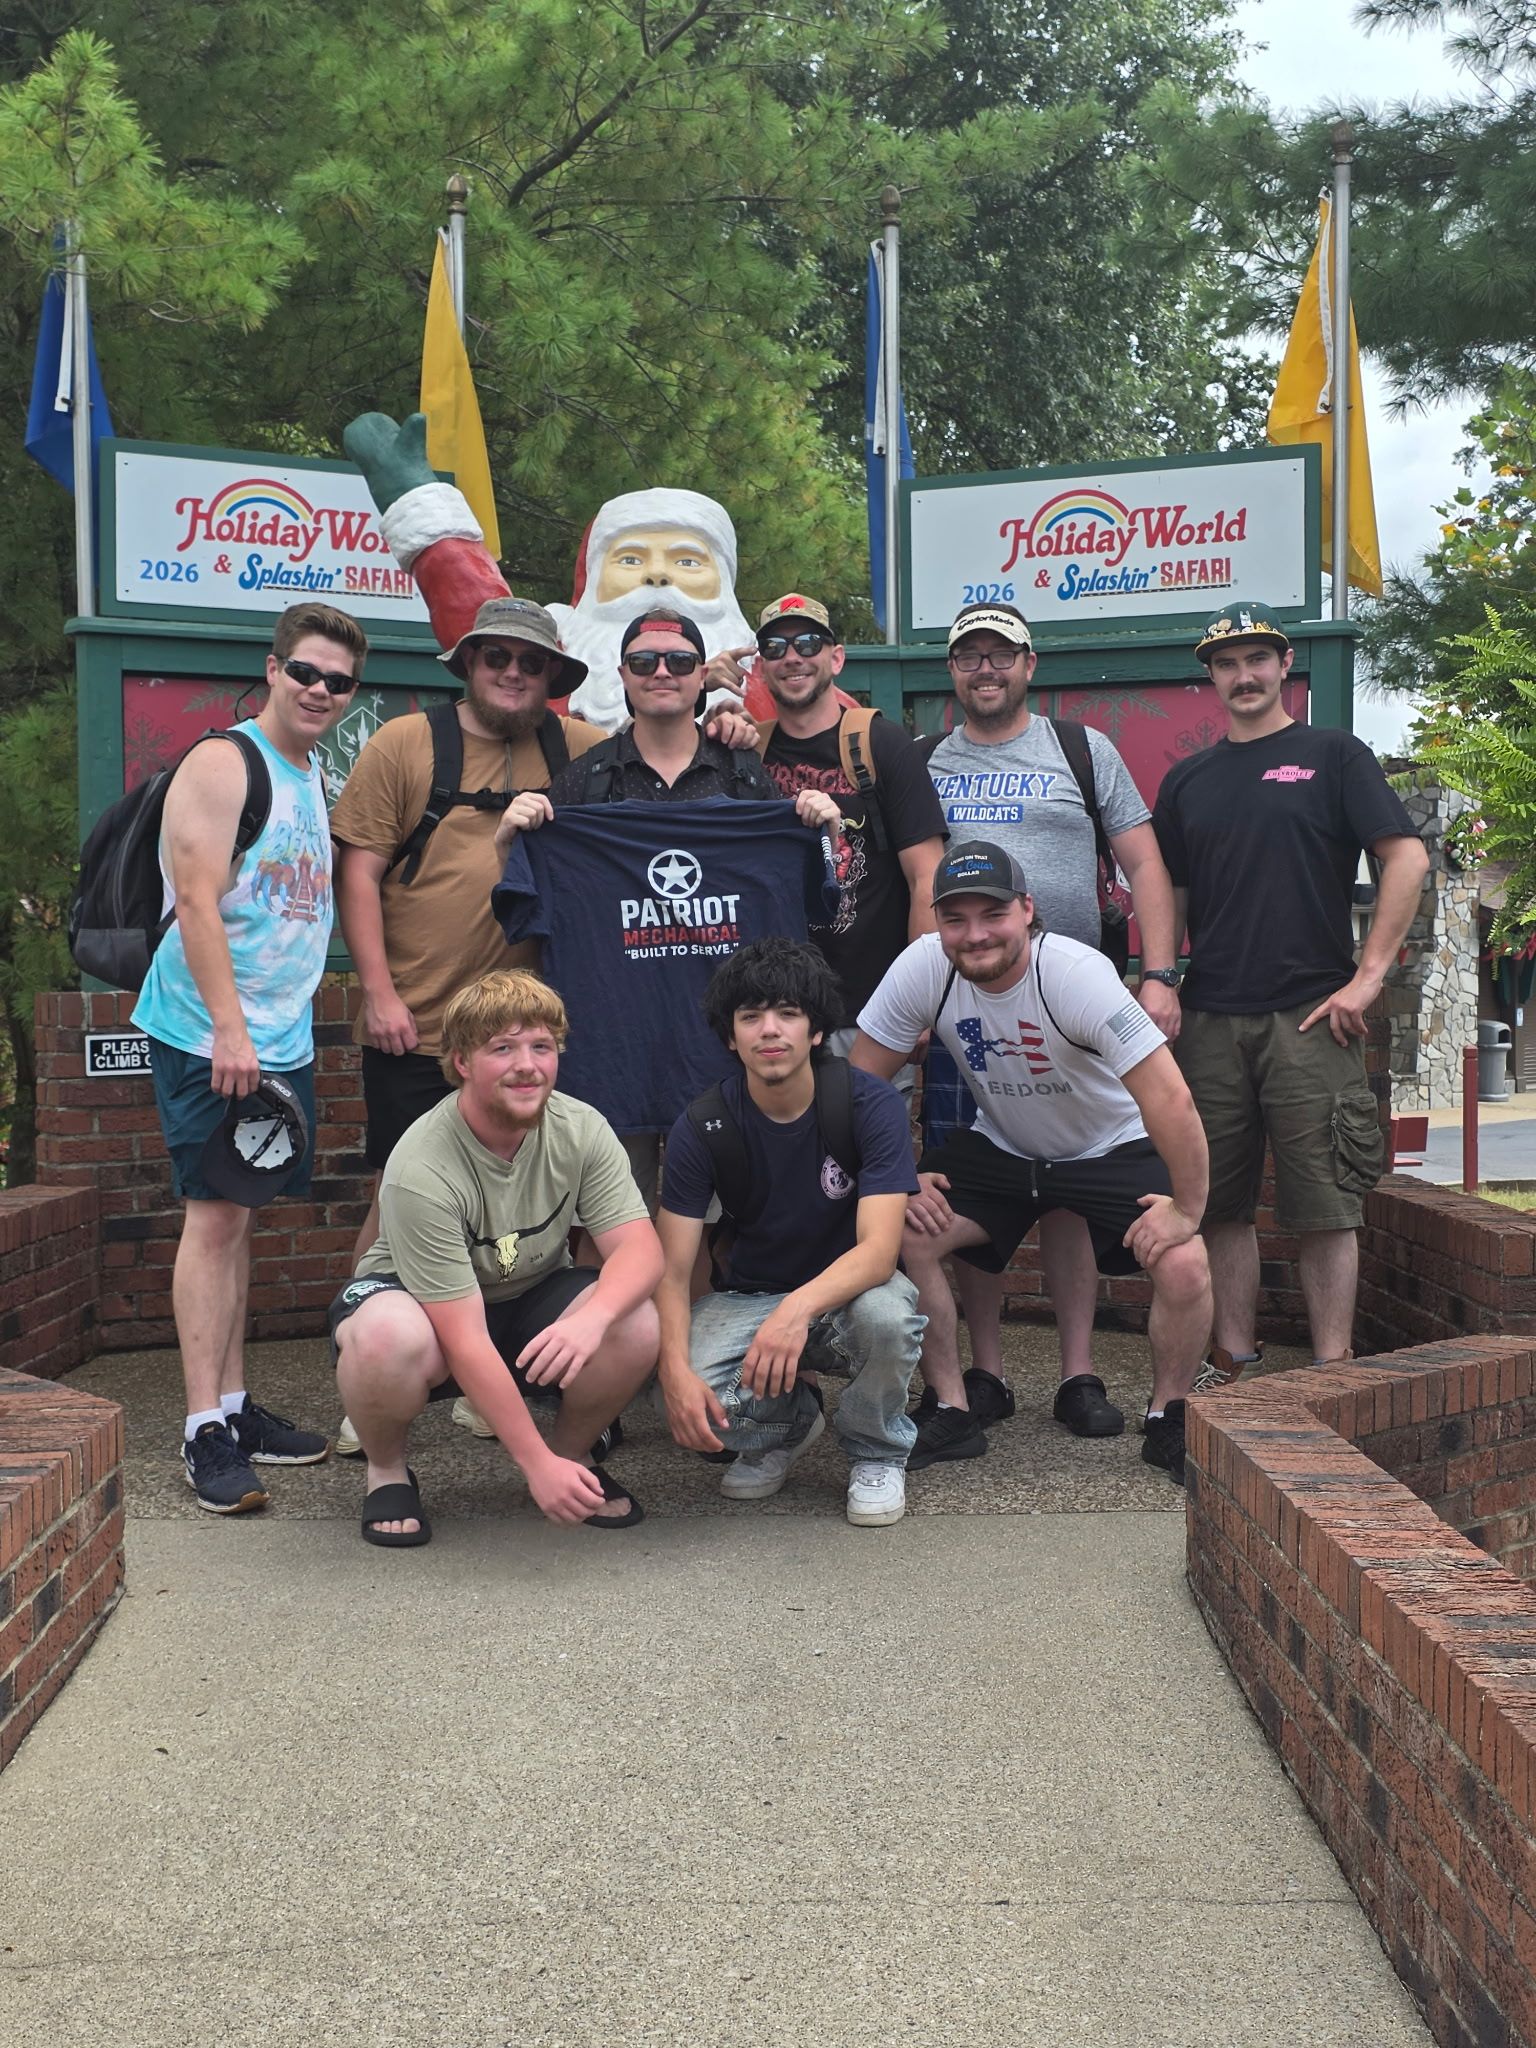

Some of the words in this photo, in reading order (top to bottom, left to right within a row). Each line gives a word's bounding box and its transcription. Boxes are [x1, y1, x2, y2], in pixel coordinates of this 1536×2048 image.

[175, 497, 323, 562] Holiday
[313, 508, 392, 554] Wor
[1000, 518, 1139, 573] Holiday
[1128, 504, 1247, 549] World
[139, 559, 199, 583] 2026
[213, 553, 232, 574] &
[237, 553, 343, 591] Splashin'
[345, 566, 413, 594] SAFARI
[1034, 568, 1052, 589] &
[1056, 563, 1157, 601] Splashin'
[1160, 556, 1231, 588] SAFARI
[962, 581, 1015, 605] 2026
[957, 614, 1014, 631] TaylorMade
[953, 805, 1019, 822] WILDCATS
[620, 894, 741, 930] PATRIOT
[623, 924, 741, 947] MECHANICAL
[670, 945, 688, 957] TO
[102, 1040, 150, 1055] PLEAS
[95, 1054, 142, 1069] CLIMB
[972, 1079, 1073, 1097] EEDOM
